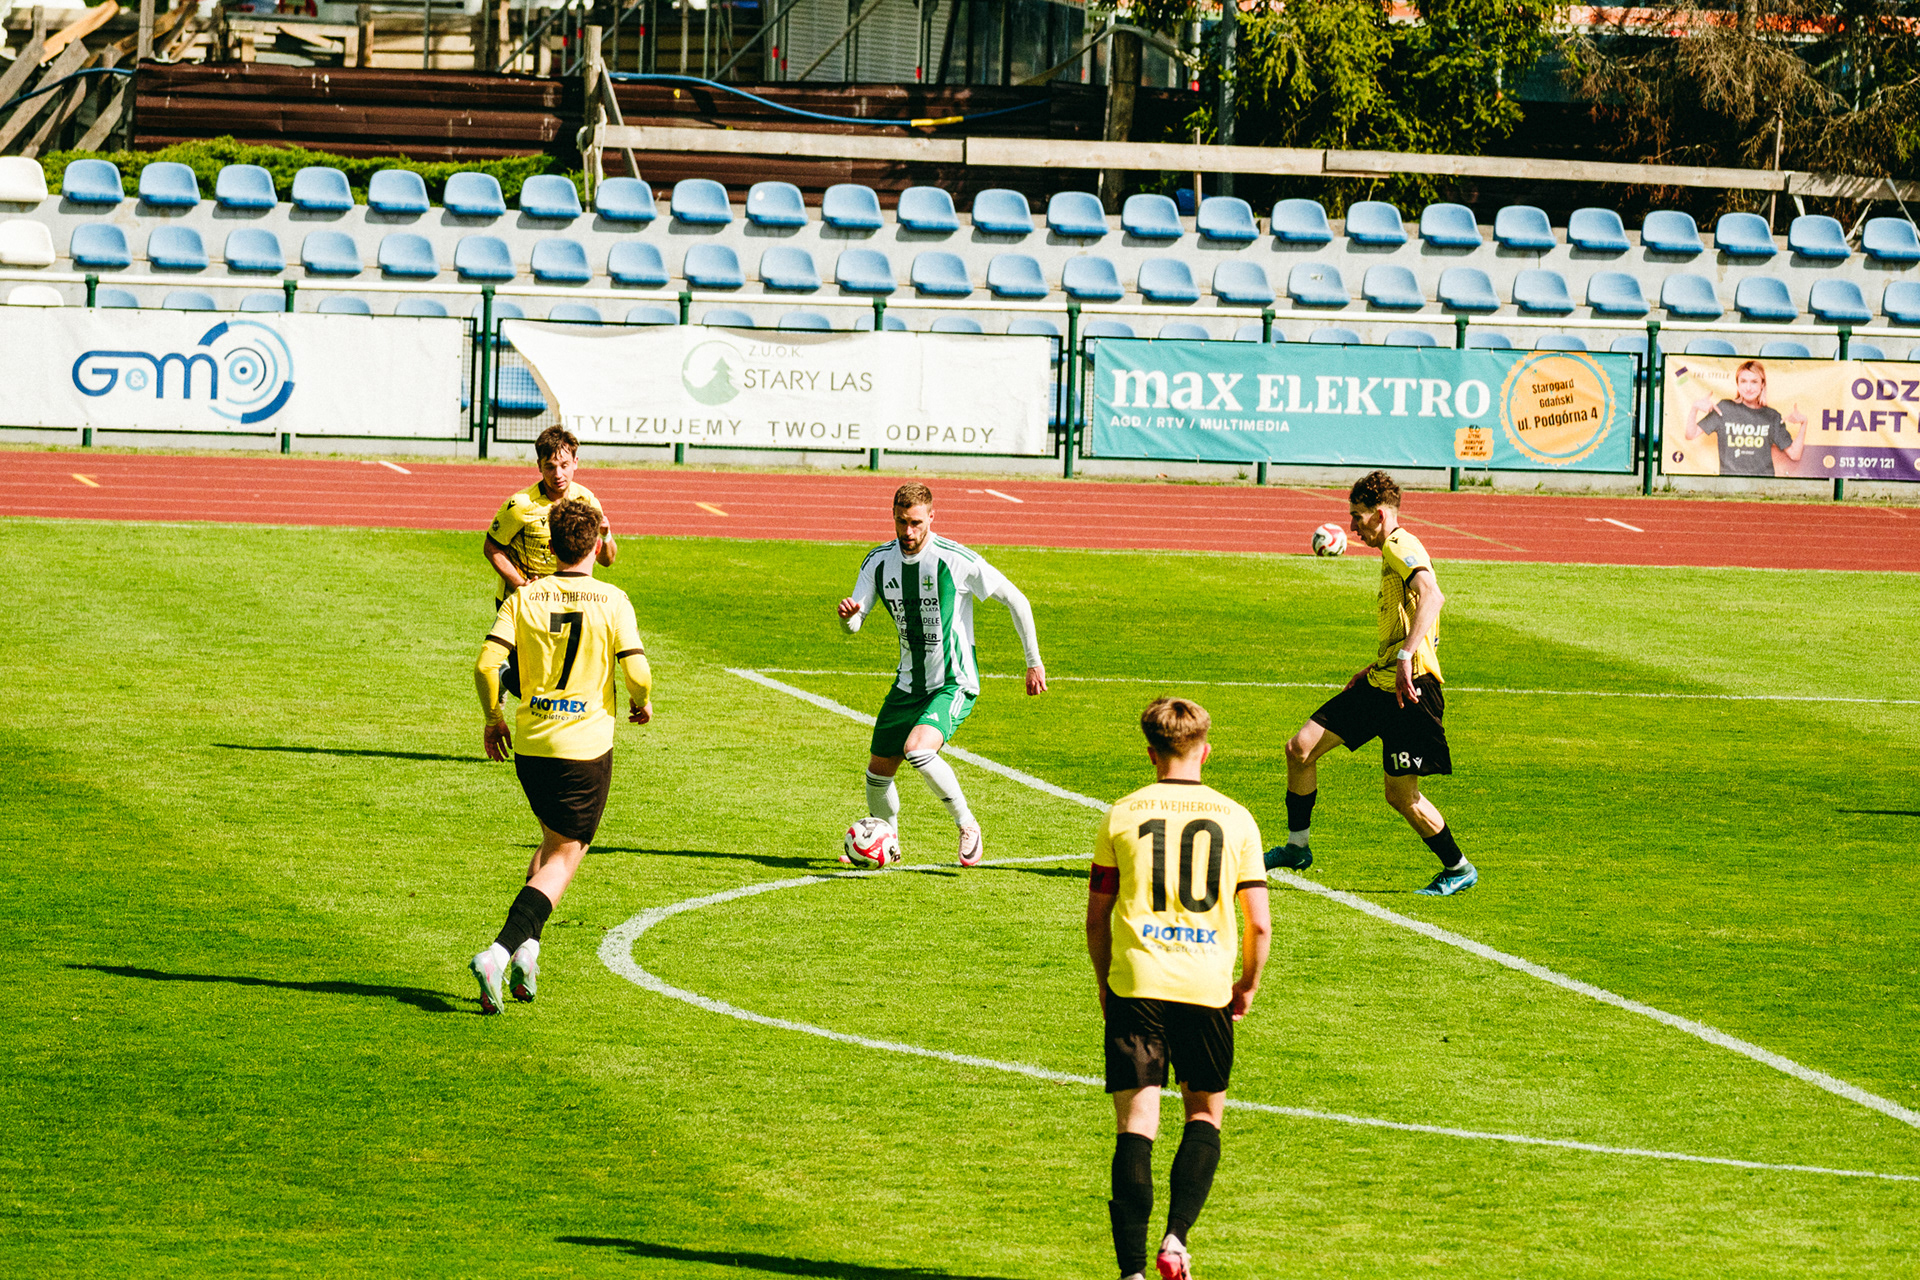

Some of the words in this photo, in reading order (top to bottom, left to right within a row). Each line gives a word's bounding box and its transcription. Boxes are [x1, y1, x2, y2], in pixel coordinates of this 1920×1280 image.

[743, 368, 820, 391] STARY
[830, 371, 873, 393] LAS
[1531, 378, 1575, 394] Starogard
[1851, 377, 1920, 402] ODZ
[1110, 369, 1244, 411] max
[1255, 373, 1491, 419] ELEKTRO
[1539, 393, 1574, 408] Gdański
[1110, 415, 1142, 427] AGD
[1156, 416, 1185, 429] RTV
[1200, 418, 1290, 432] MULTIMEDIA
[1517, 418, 1532, 431] ul.
[1534, 409, 1588, 429] Podgórna
[1591, 406, 1598, 420] 4
[1821, 409, 1909, 433] HAFT
[768, 420, 861, 440] TWOJE
[886, 424, 994, 444] ODPADY
[1724, 422, 1770, 437] TWOJE
[1727, 435, 1764, 448] LOGO
[1839, 457, 1855, 468] 513
[1857, 457, 1878, 468] 307
[1880, 458, 1895, 469] 121
[529, 591, 551, 601] GRYF
[553, 591, 608, 604] WEJHEROWO
[549, 611, 584, 691] 7
[530, 697, 587, 713] PIOTREX
[1390, 751, 1411, 770] 18
[1129, 799, 1157, 812] GRYF
[1159, 800, 1231, 816] WEJHEROWO
[1138, 818, 1224, 913] 10
[1142, 924, 1218, 945] PIOTREX
